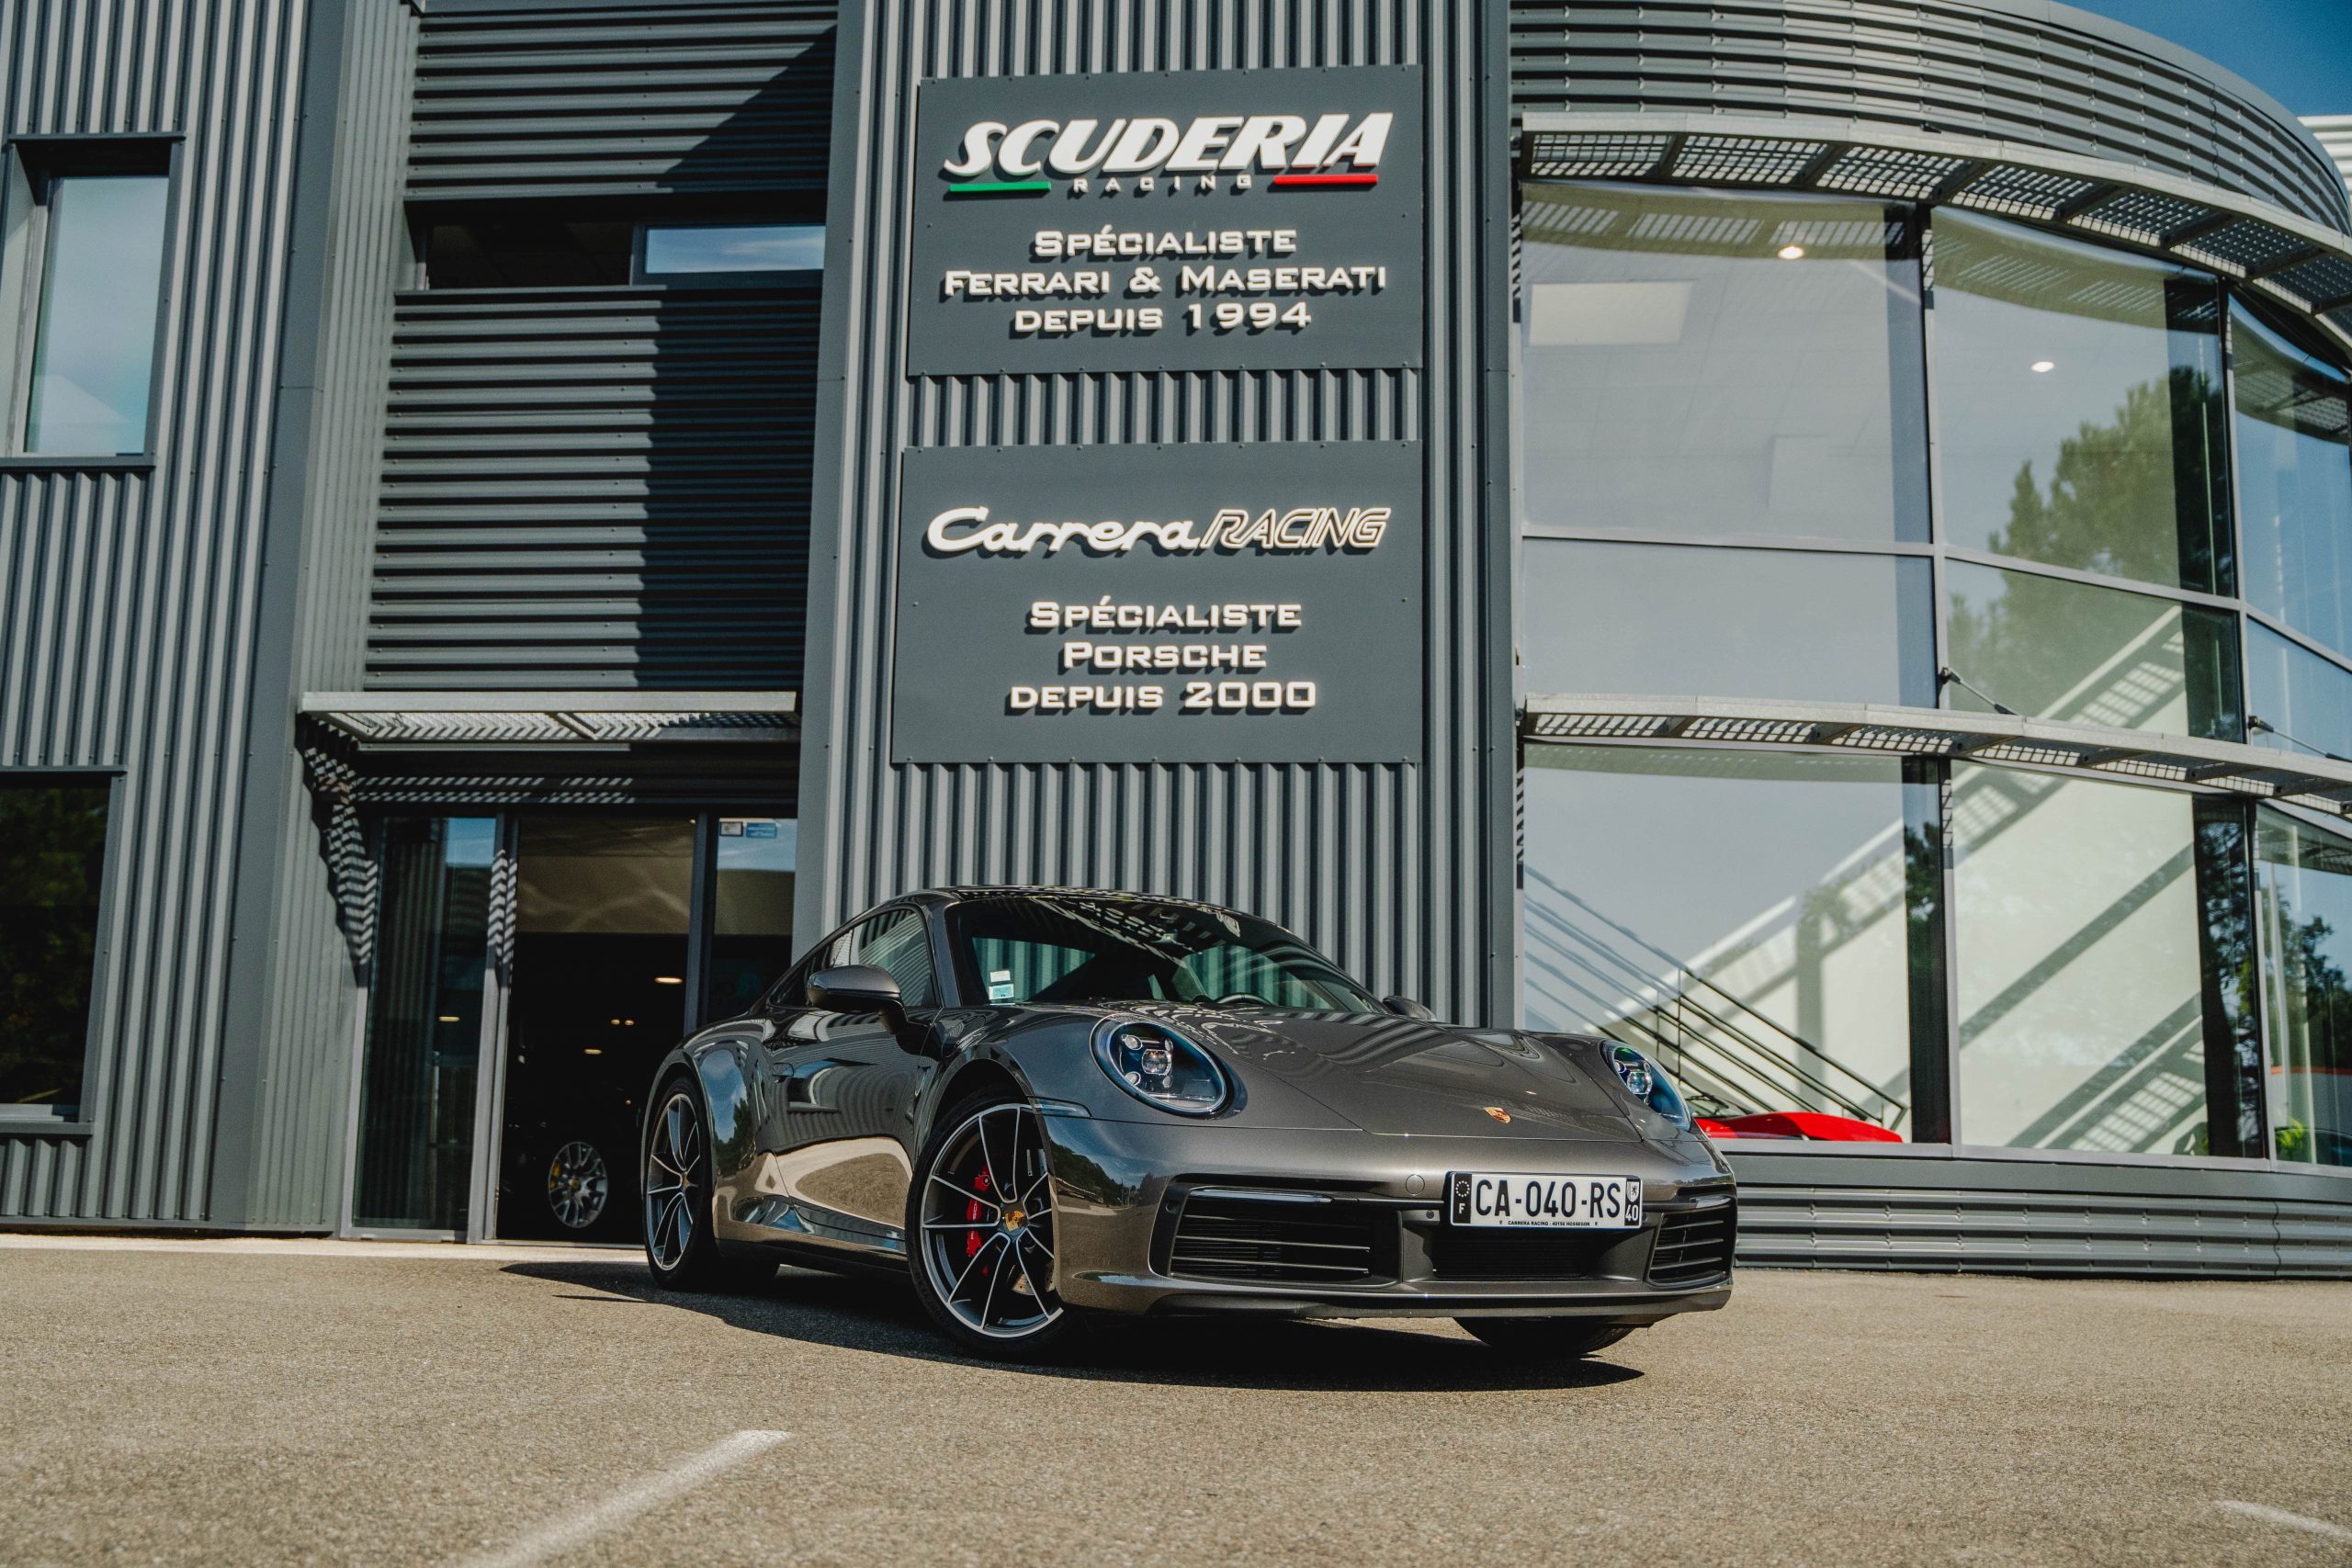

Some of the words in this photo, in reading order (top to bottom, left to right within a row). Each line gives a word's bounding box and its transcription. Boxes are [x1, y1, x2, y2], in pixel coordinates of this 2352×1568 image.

[944, 112, 1393, 175] SCUDERIA
[1074, 175, 1251, 192] RACING
[1035, 224, 1296, 255] SPÉCIALISTE
[945, 270, 1110, 296] FERRARI
[1130, 266, 1162, 292] &
[1182, 265, 1385, 290] MASERATI
[1015, 308, 1163, 331] DEPUIS
[1189, 302, 1311, 328] 1994
[928, 506, 1200, 551] Carrera
[1200, 507, 1391, 548] RACING
[1031, 595, 1302, 627] SPÉCIALISTE
[1064, 642, 1267, 668] PORSCHE
[1011, 686, 1164, 708] DEPUIS
[1185, 681, 1317, 707] 2000
[1458, 1202, 1465, 1213] F
[1476, 1179, 1621, 1218] CA-040-RS
[1625, 1205, 1639, 1222] 40
